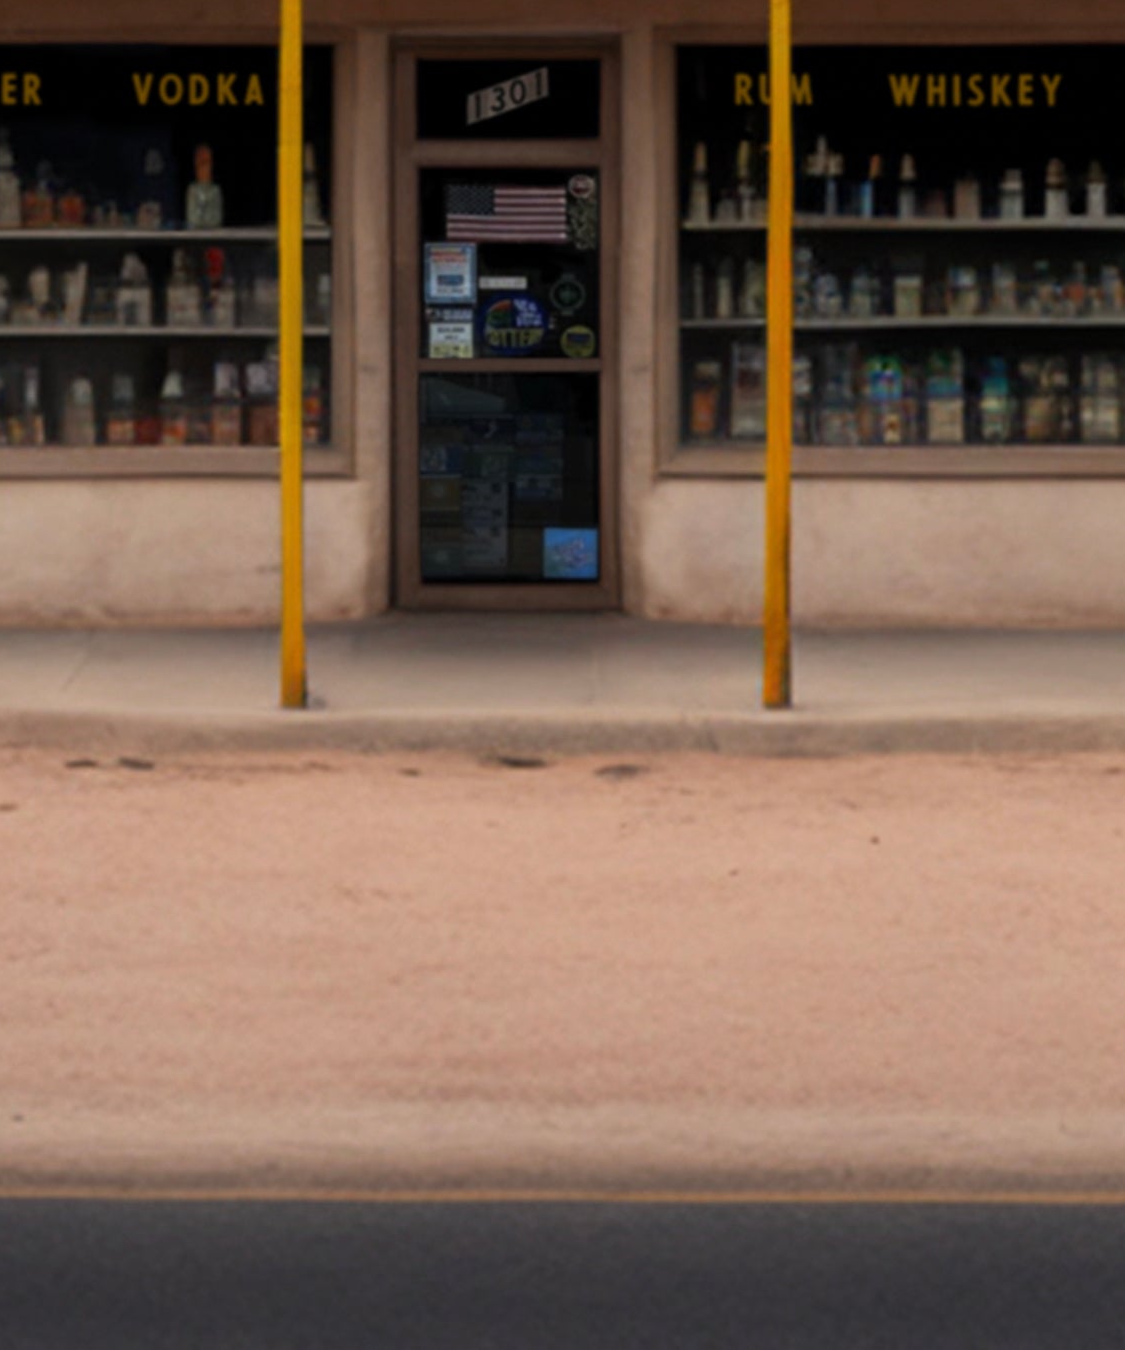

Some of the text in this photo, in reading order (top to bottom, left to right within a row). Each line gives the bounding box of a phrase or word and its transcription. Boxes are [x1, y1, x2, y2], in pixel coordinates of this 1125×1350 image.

[132, 73, 265, 106] VODKA
[475, 70, 543, 120] 1301
[889, 73, 1063, 108] WHISKEY
